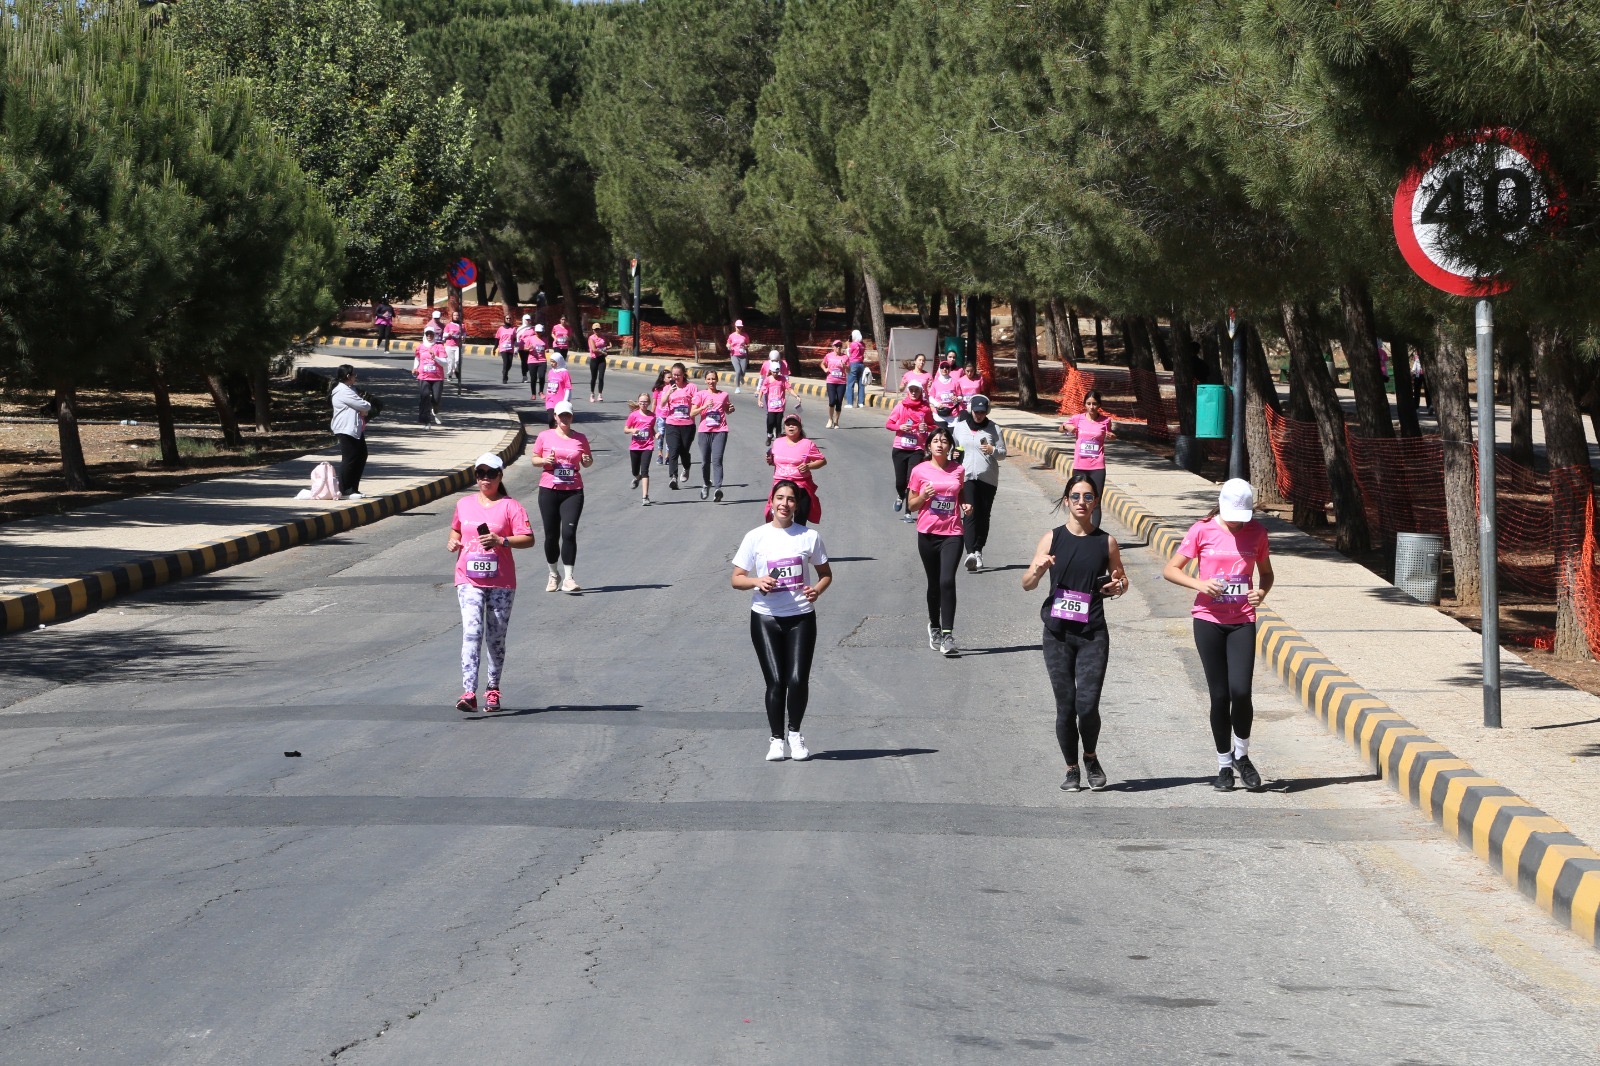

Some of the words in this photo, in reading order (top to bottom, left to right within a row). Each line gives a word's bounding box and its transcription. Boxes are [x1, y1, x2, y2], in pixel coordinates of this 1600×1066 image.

[1421, 167, 1532, 234] 40
[937, 501, 951, 509] 790
[473, 561, 491, 571] 693
[1223, 583, 1242, 594] 271
[1060, 599, 1082, 612] 265
